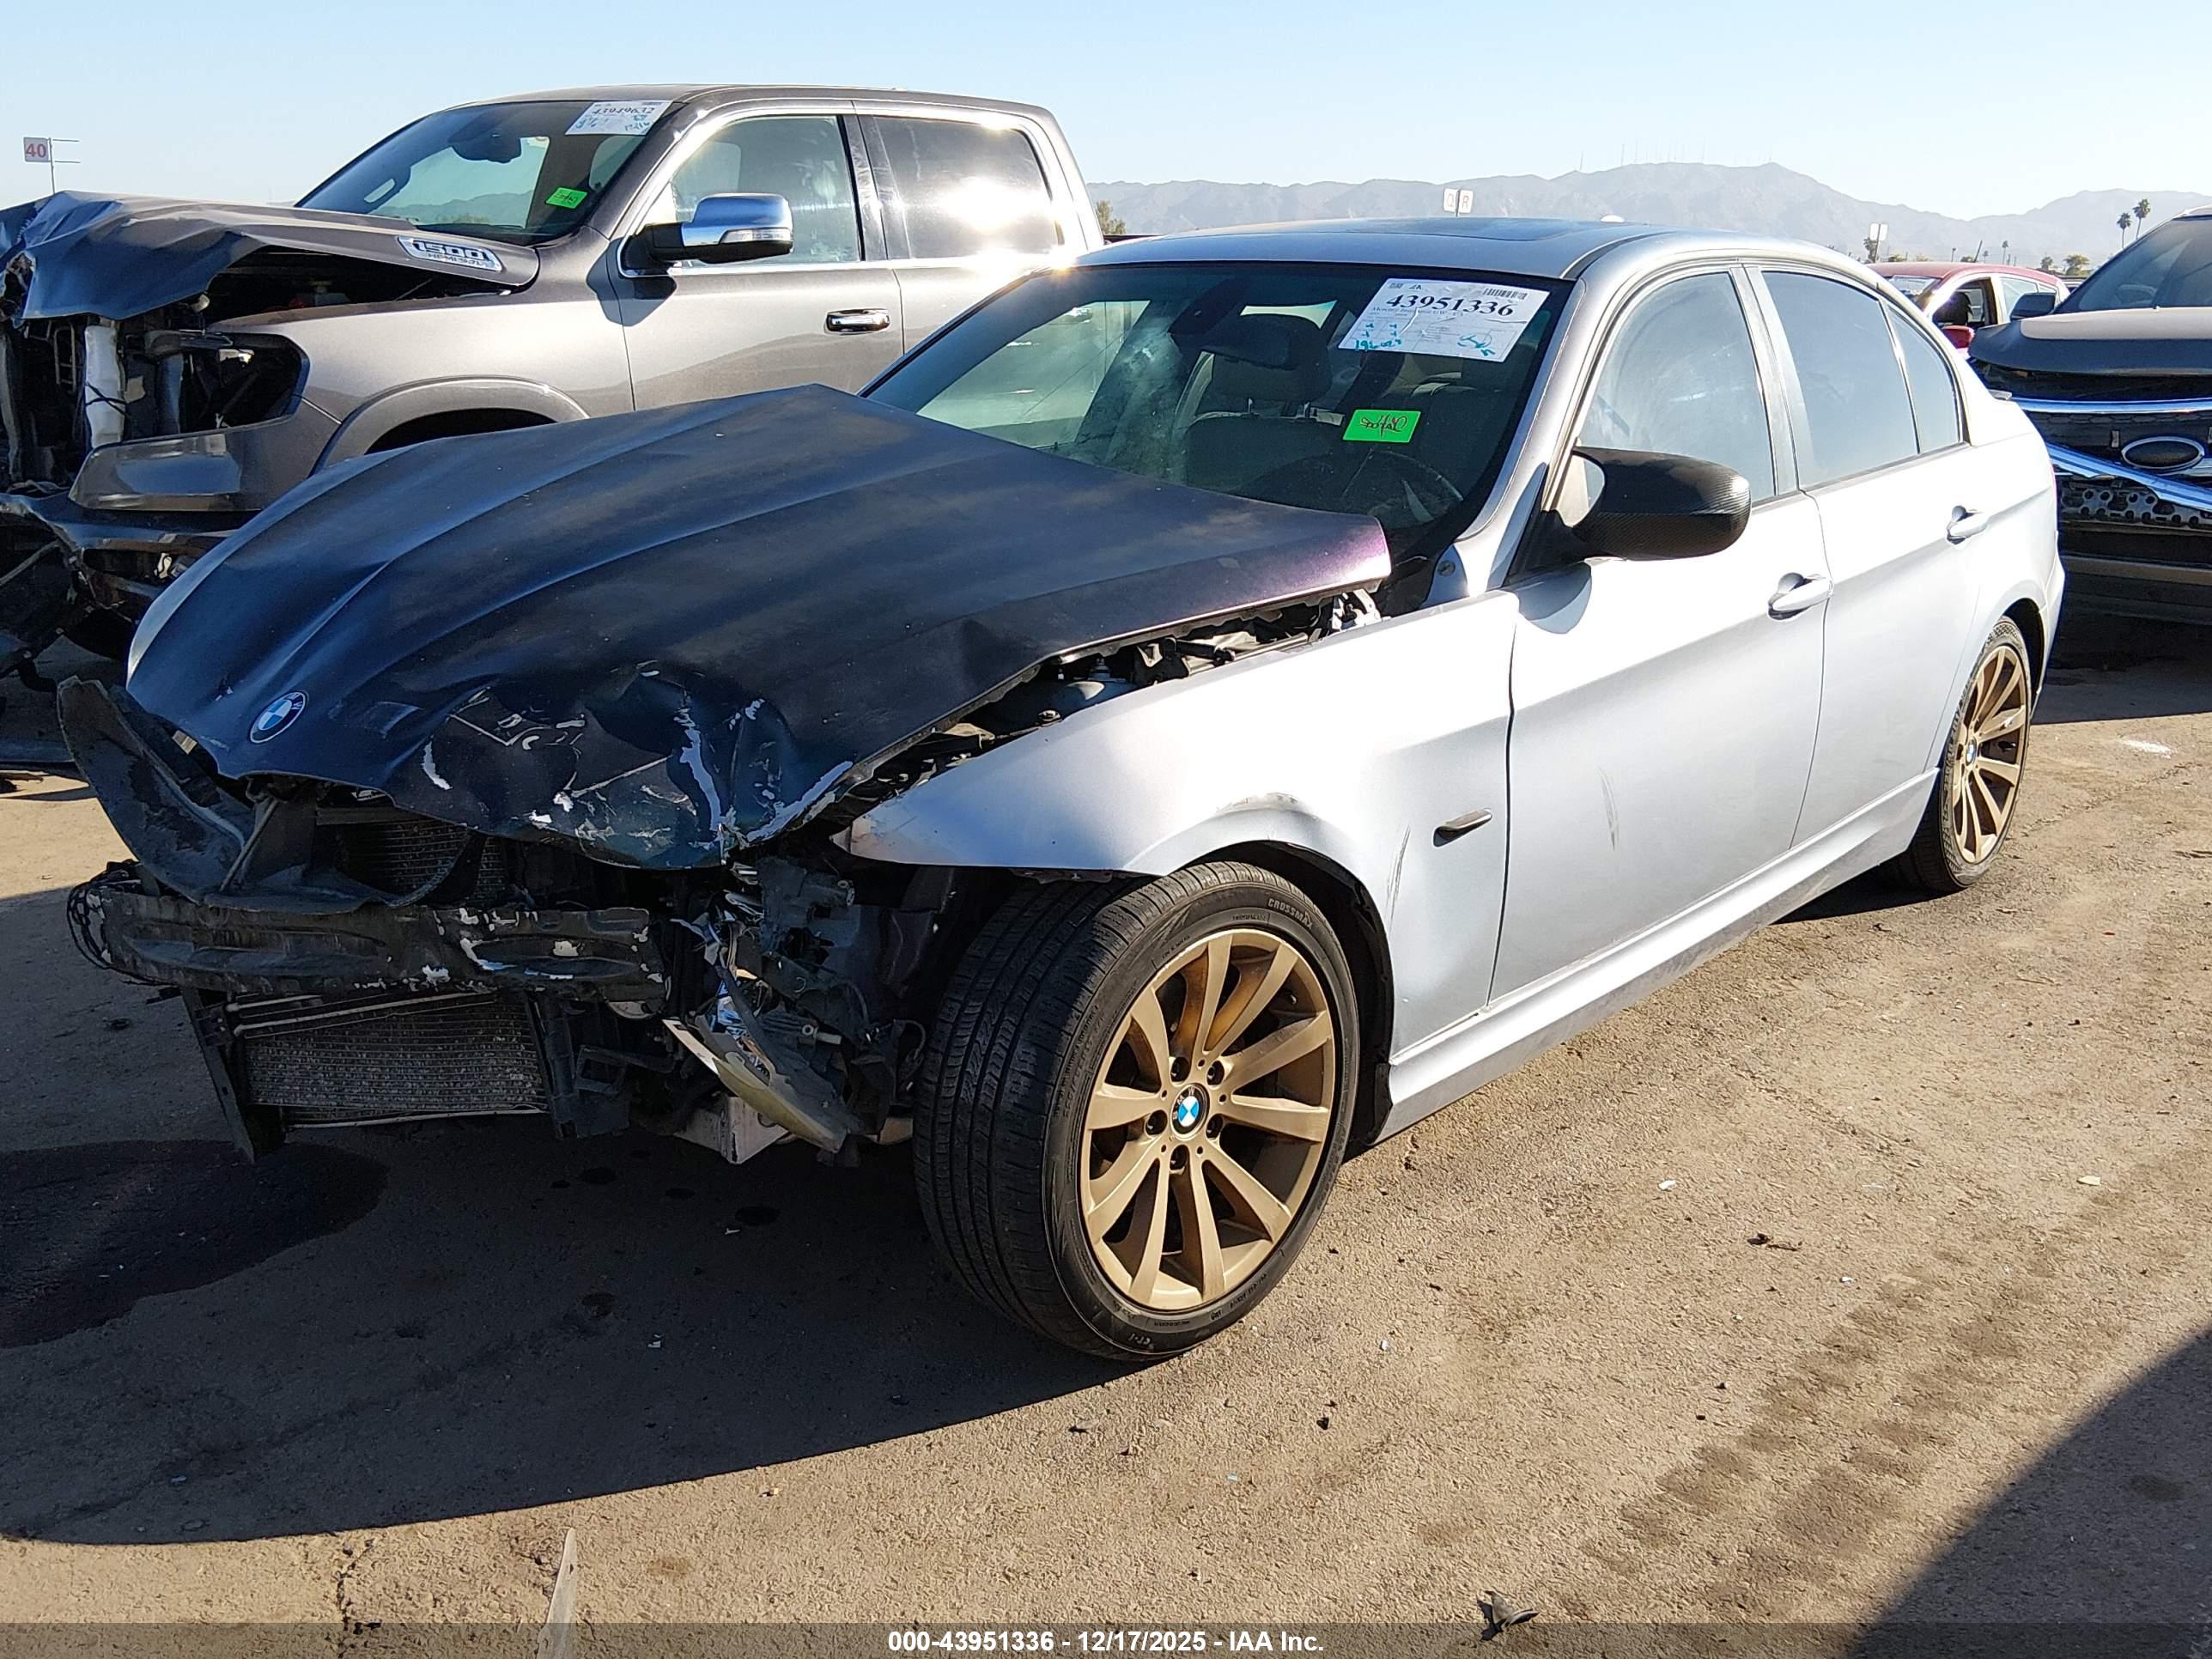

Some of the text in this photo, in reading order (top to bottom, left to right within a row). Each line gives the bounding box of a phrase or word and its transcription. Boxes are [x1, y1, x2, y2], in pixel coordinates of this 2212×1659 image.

[26, 143, 47, 158] 40
[412, 240, 486, 260] 1500
[1386, 294, 1515, 317] 43951336
[1267, 897, 1313, 930] CROSSMAX
